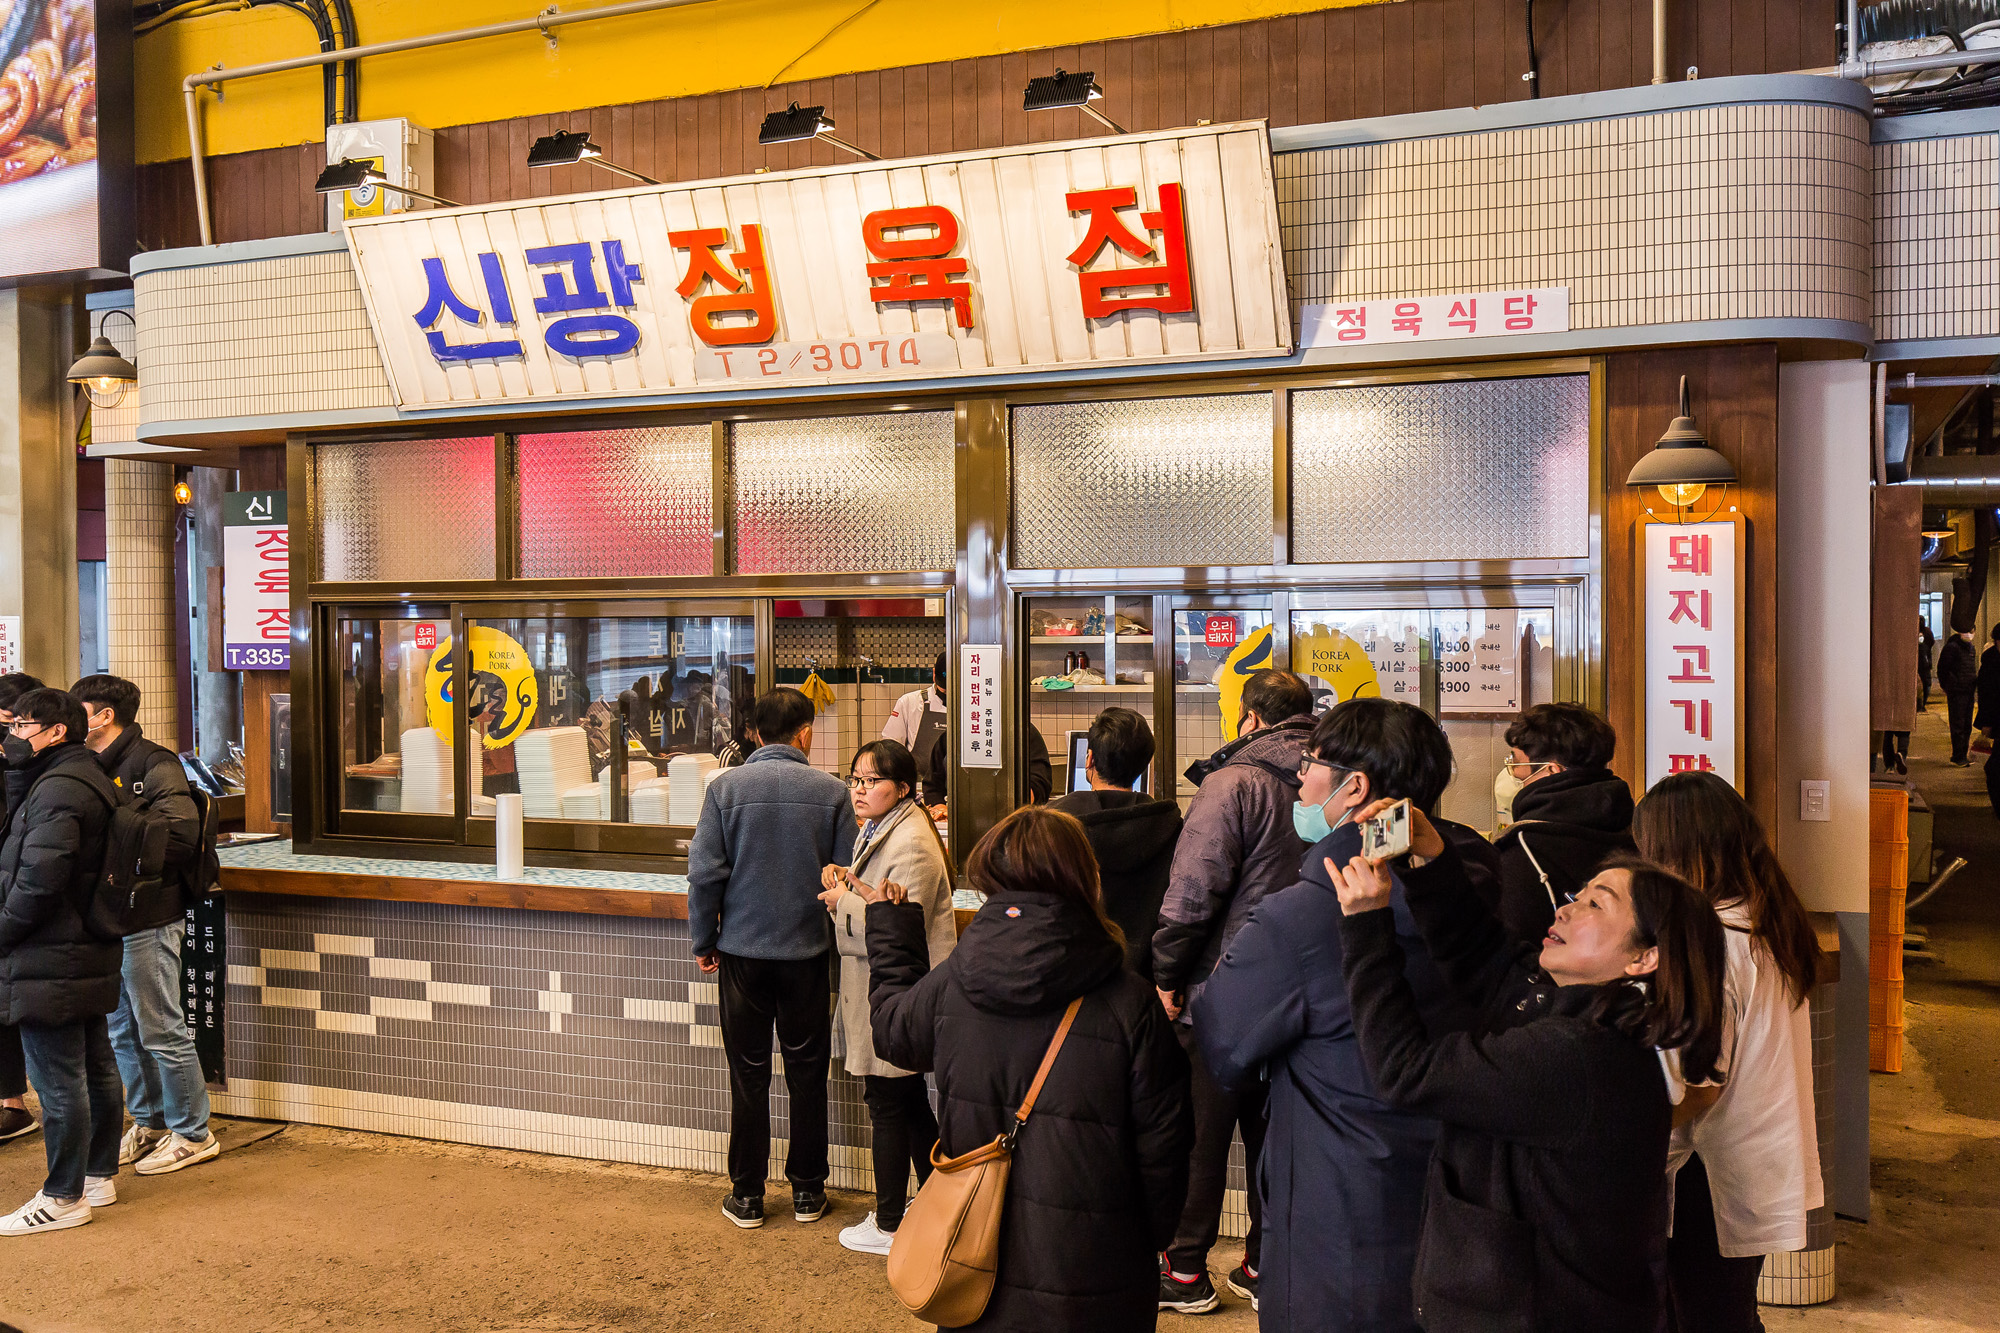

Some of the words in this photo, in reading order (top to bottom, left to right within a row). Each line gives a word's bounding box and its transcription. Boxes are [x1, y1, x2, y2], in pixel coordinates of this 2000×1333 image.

[413, 239, 645, 362] 신광
[1336, 294, 1538, 341] 정육식당
[1209, 620, 1233, 632] 우리
[417, 627, 435, 637] 우리
[1208, 632, 1233, 643] 돼지
[417, 637, 435, 646] 돼지
[1480, 643, 1501, 651] 국내산
[489, 650, 516, 659] KOREA
[1312, 650, 1350, 660] KOREA
[489, 661, 511, 669] PORK
[971, 654, 980, 677] 자리
[1312, 662, 1343, 672] PORK
[985, 678, 992, 696] 메뉴
[971, 683, 980, 706] 먼저
[971, 711, 980, 734] 확보
[971, 741, 980, 752] 후
[186, 909, 196, 950] 직원이
[204, 926, 214, 953] 드신
